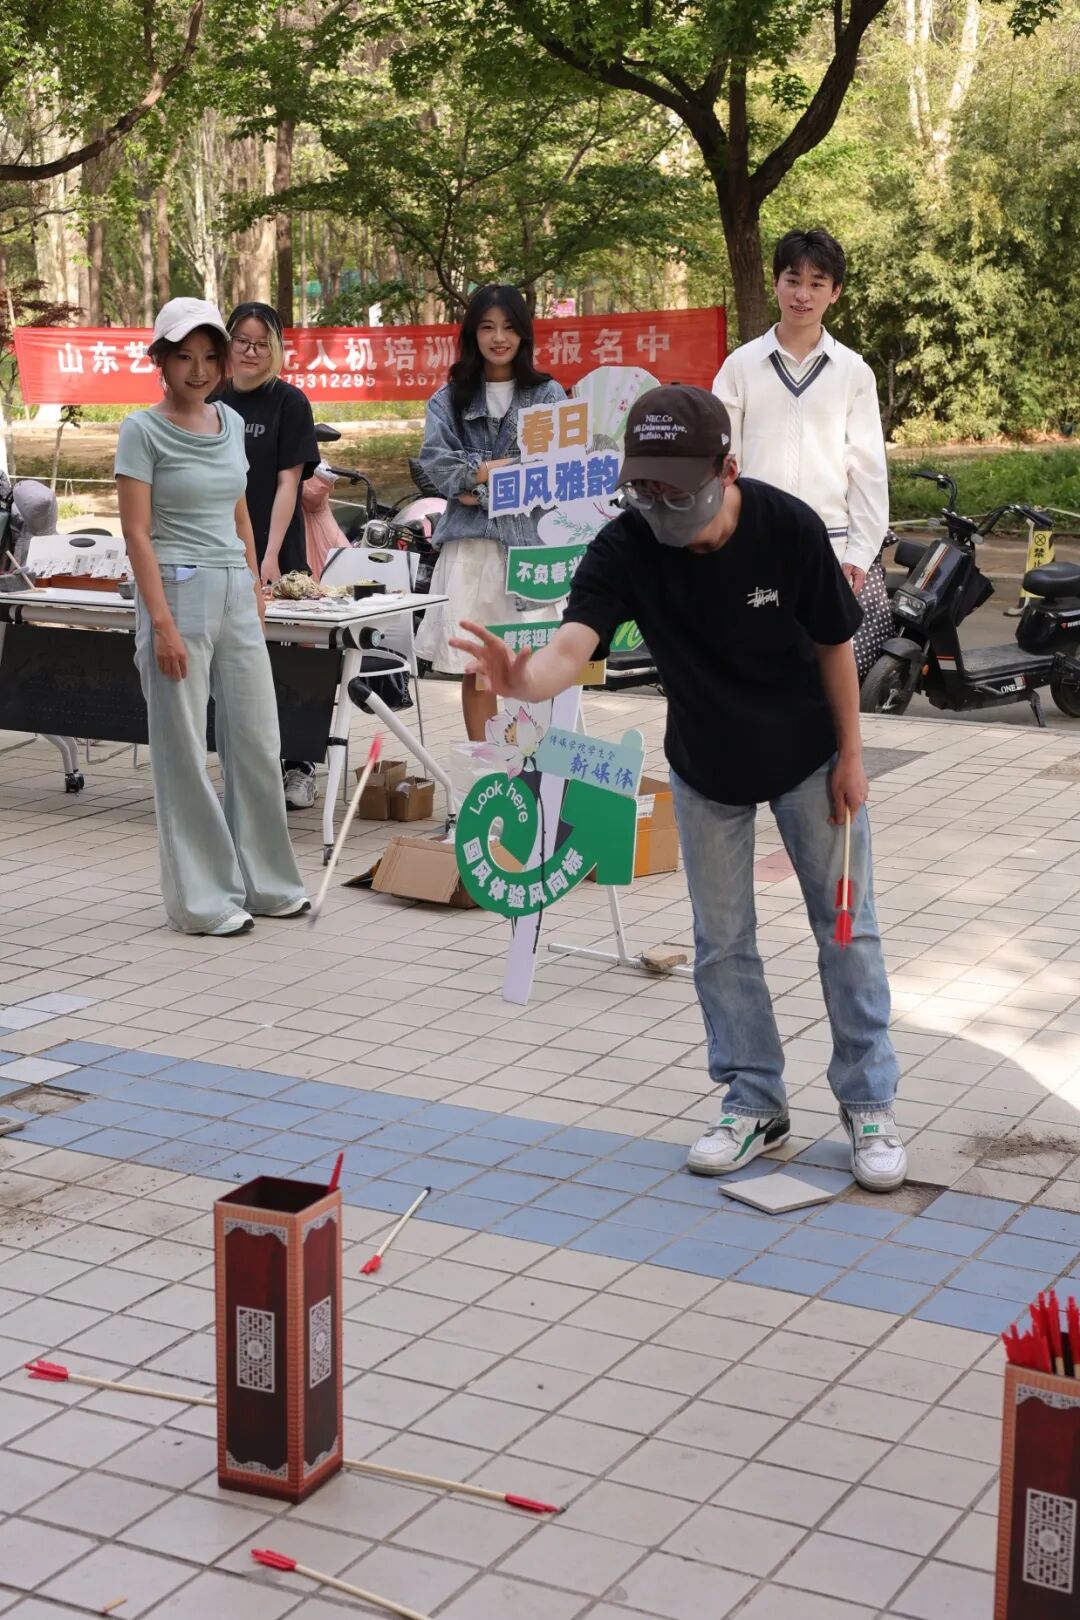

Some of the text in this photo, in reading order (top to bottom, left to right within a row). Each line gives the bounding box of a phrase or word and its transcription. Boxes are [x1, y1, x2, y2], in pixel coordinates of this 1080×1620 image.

[57, 341, 156, 374] 山东艺
[533, 326, 670, 365] 报名中
[278, 373, 376, 389] 75312295
[522, 402, 588, 455] 春日
[492, 455, 619, 512] 国风雅韵
[570, 753, 634, 789] 新媒体
[469, 780, 529, 823] Look here
